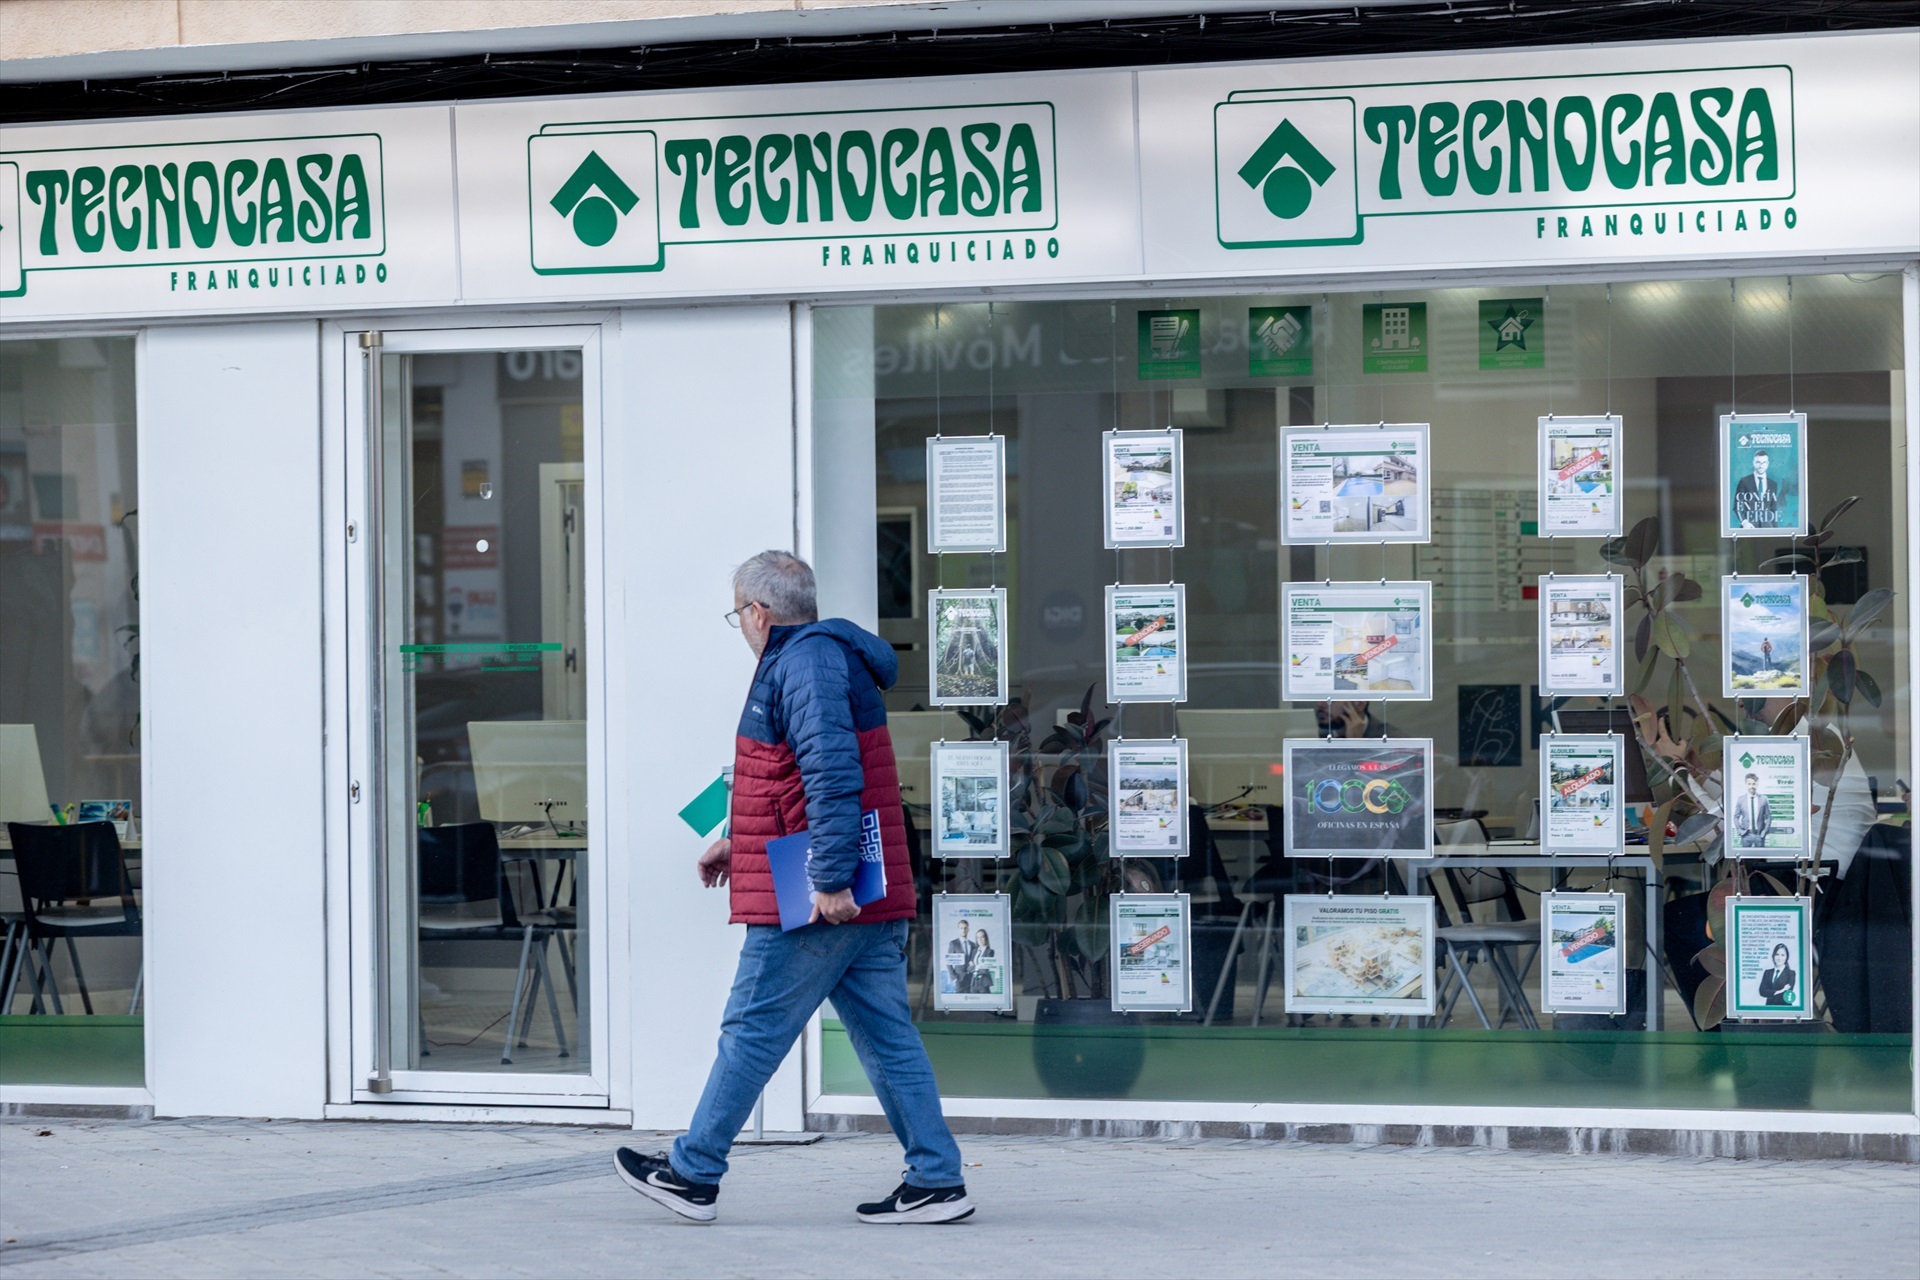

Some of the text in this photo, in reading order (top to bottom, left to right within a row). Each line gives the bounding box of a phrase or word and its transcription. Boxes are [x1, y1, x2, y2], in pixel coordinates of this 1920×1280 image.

[1364, 87, 1778, 200] TECNOCASA
[665, 122, 1042, 228] TECNOCASA
[26, 154, 370, 255] TECNOCASA
[1537, 207, 1798, 239] FRANQUICIADO
[822, 237, 1059, 266] FRANQUICIADO
[171, 263, 388, 291] FRANQUICIADO
[1565, 456, 1594, 476] VENDIDO
[1737, 510, 1783, 522] VERDE
[1131, 621, 1160, 642] VENDIDO
[1362, 640, 1392, 660] VENDIDO
[1564, 769, 1601, 795] ALQUILADO
[1131, 928, 1167, 953] RESERVADO
[1568, 932, 1599, 952] VENDIDO
